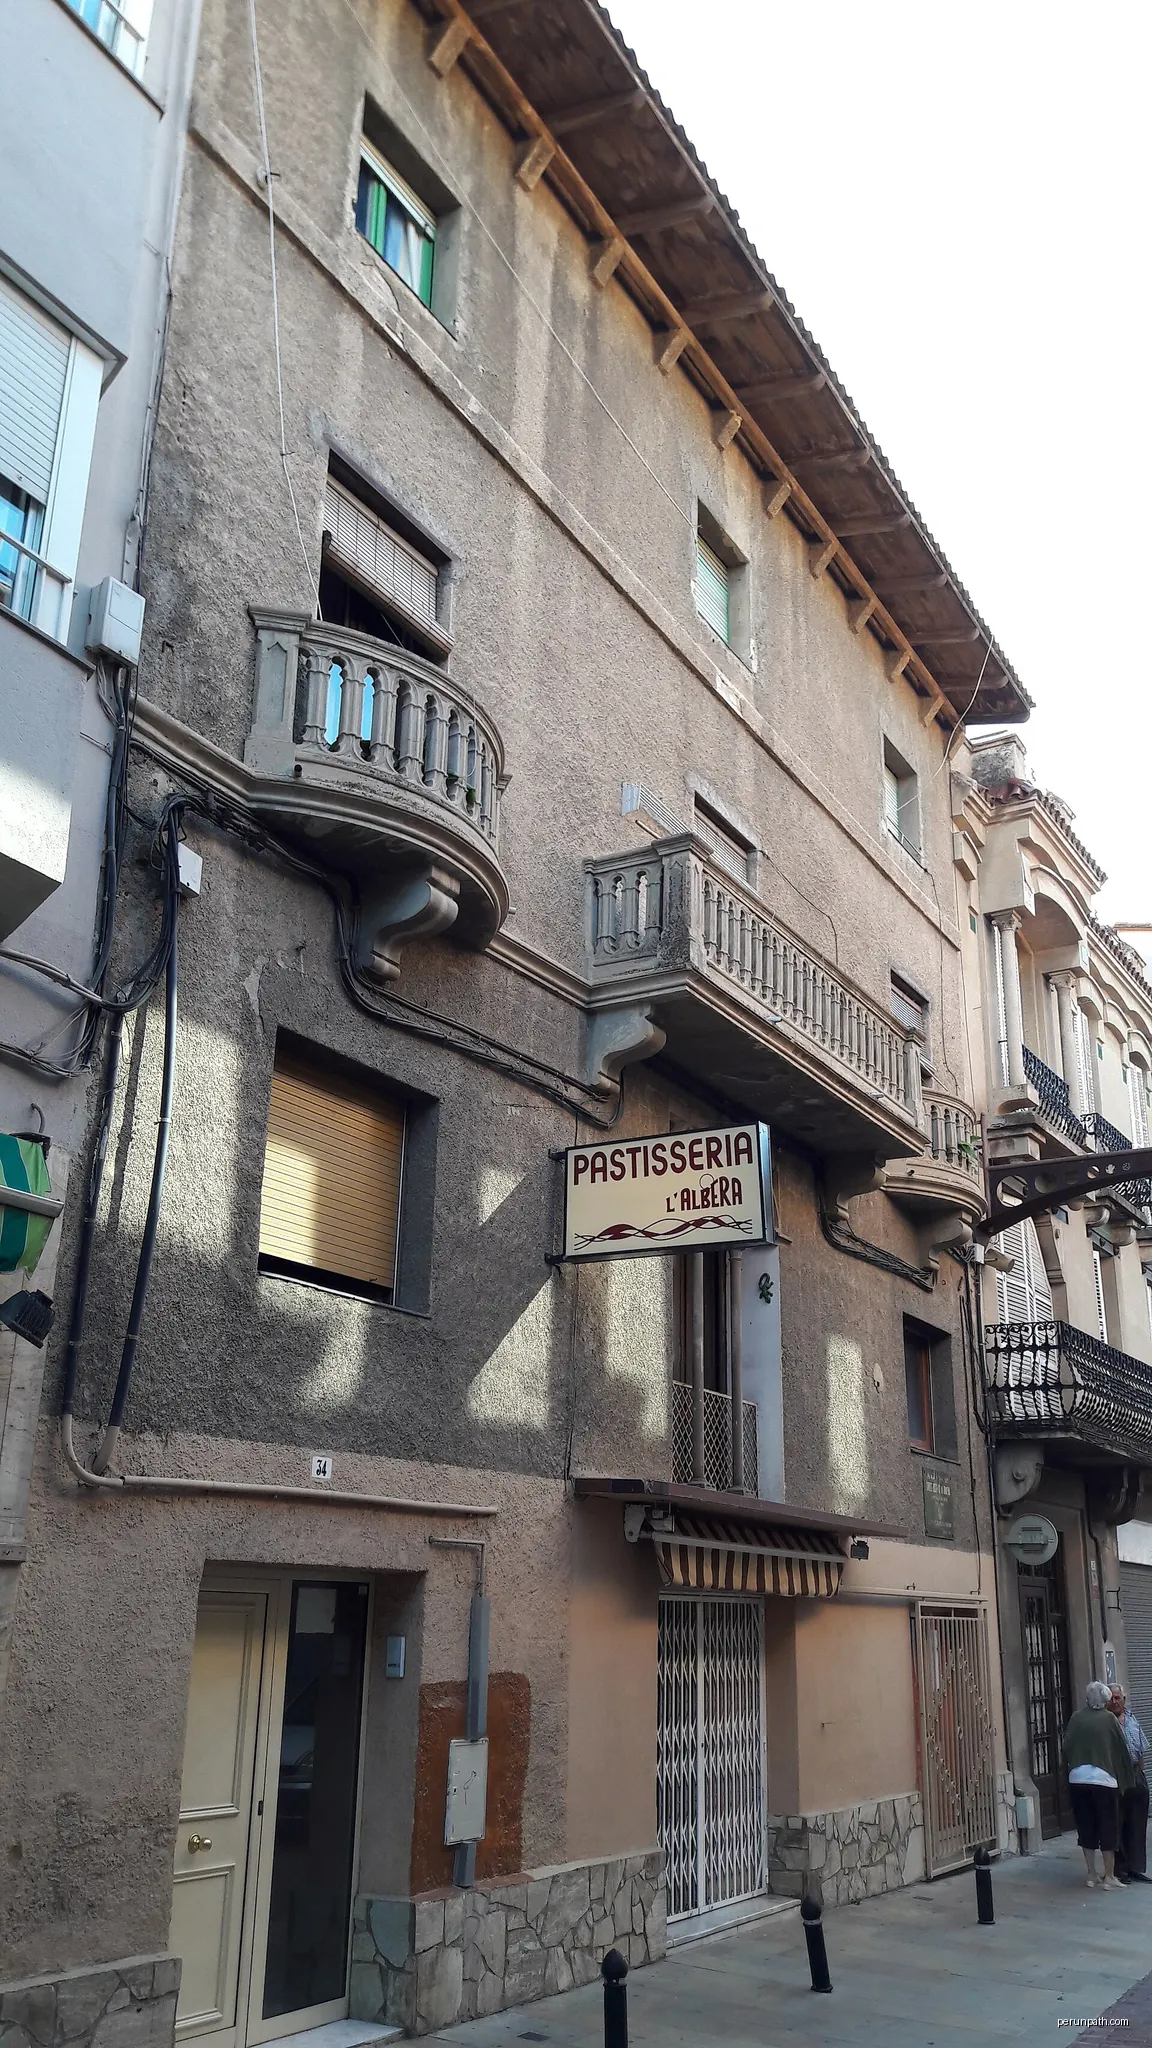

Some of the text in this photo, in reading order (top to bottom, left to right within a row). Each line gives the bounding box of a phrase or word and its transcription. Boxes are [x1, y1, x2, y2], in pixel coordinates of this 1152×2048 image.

[573, 1131, 753, 1186] PASTISSERIA
[666, 1176, 743, 1213] L'ALBERA
[316, 1459, 327, 1477] 34
